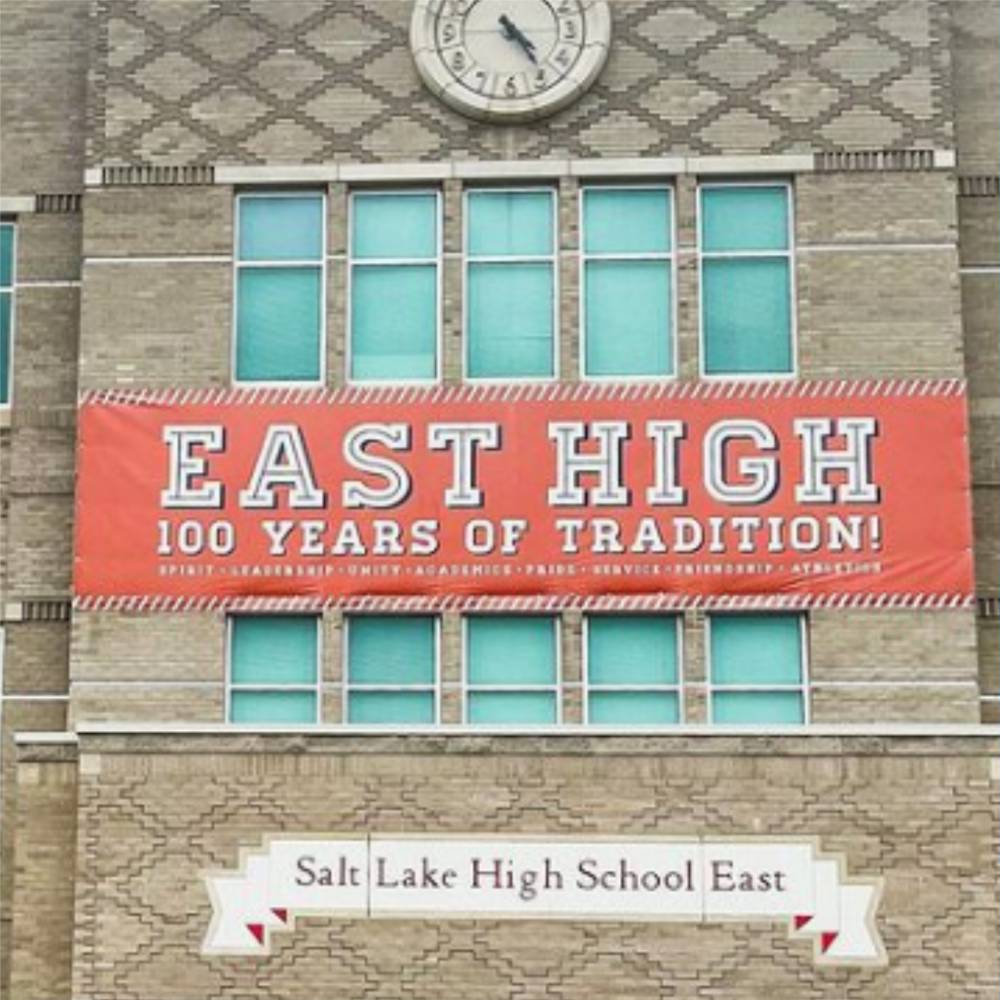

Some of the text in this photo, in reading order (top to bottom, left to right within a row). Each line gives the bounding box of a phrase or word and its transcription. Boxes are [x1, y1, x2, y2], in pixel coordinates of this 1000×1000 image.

[160, 416, 882, 510] EAST HIGH
[156, 514, 882, 557] 100 YEARS OF TRADITION!
[158, 564, 214, 577] SPIRIT
[295, 855, 788, 901] Salt Lake High School East
